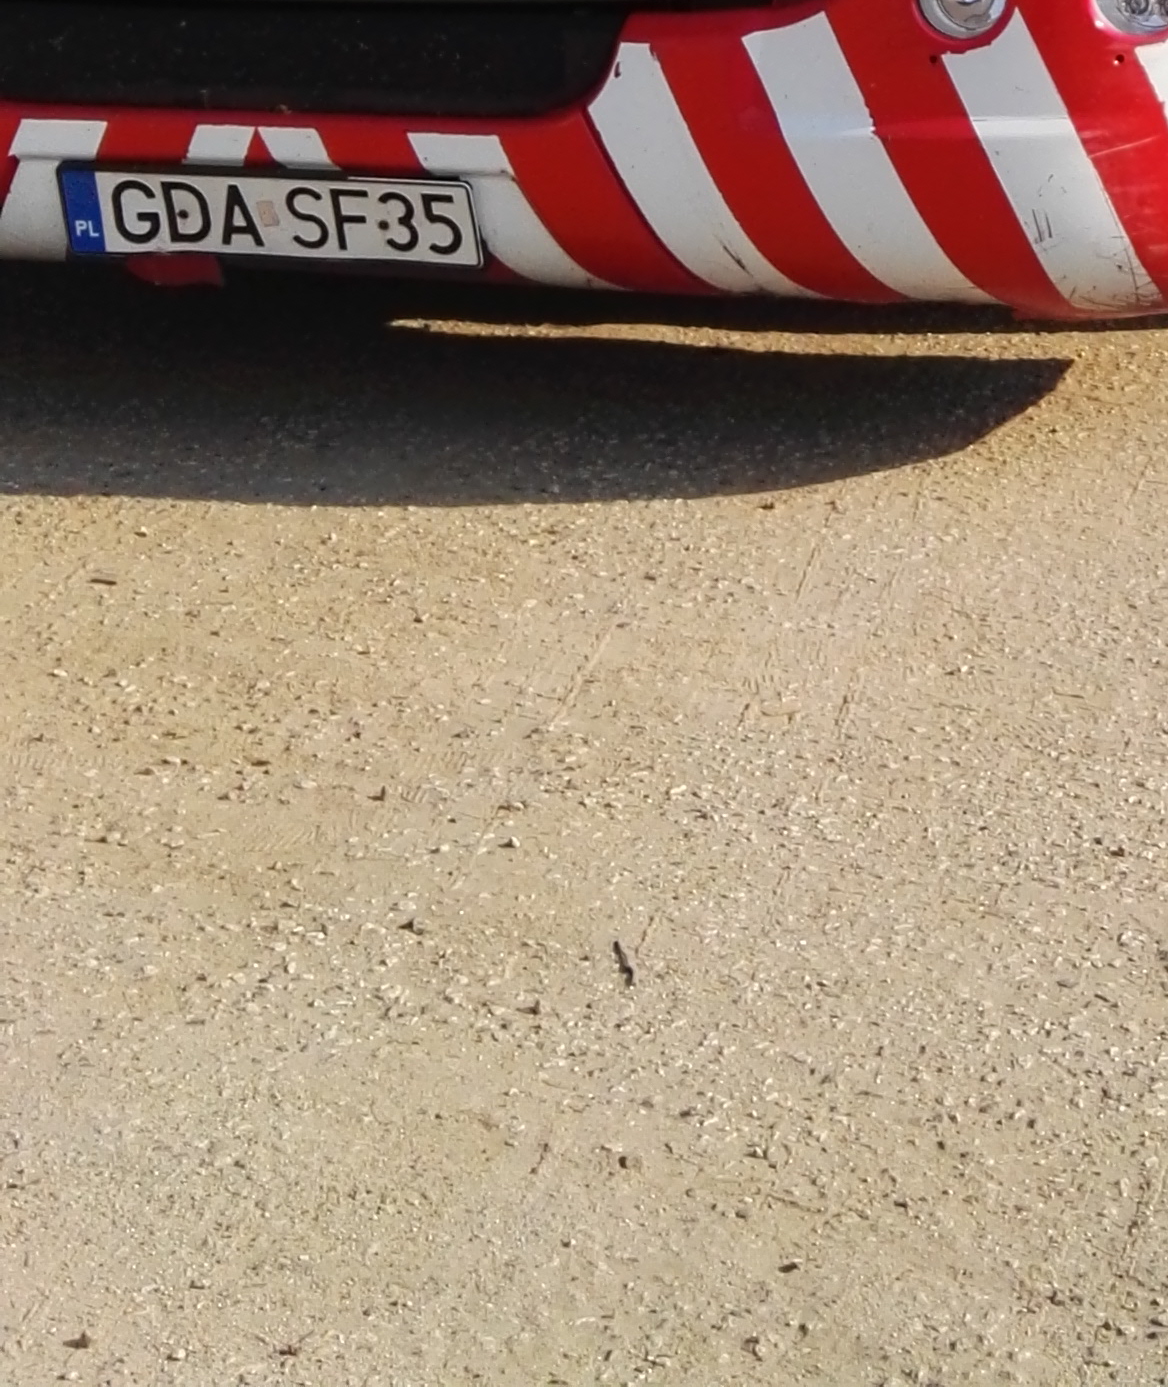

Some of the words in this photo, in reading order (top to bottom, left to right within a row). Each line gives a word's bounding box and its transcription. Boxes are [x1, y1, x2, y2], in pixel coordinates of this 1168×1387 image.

[75, 219, 99, 238] PL
[111, 178, 266, 248] GDA
[285, 185, 463, 256] SF35
